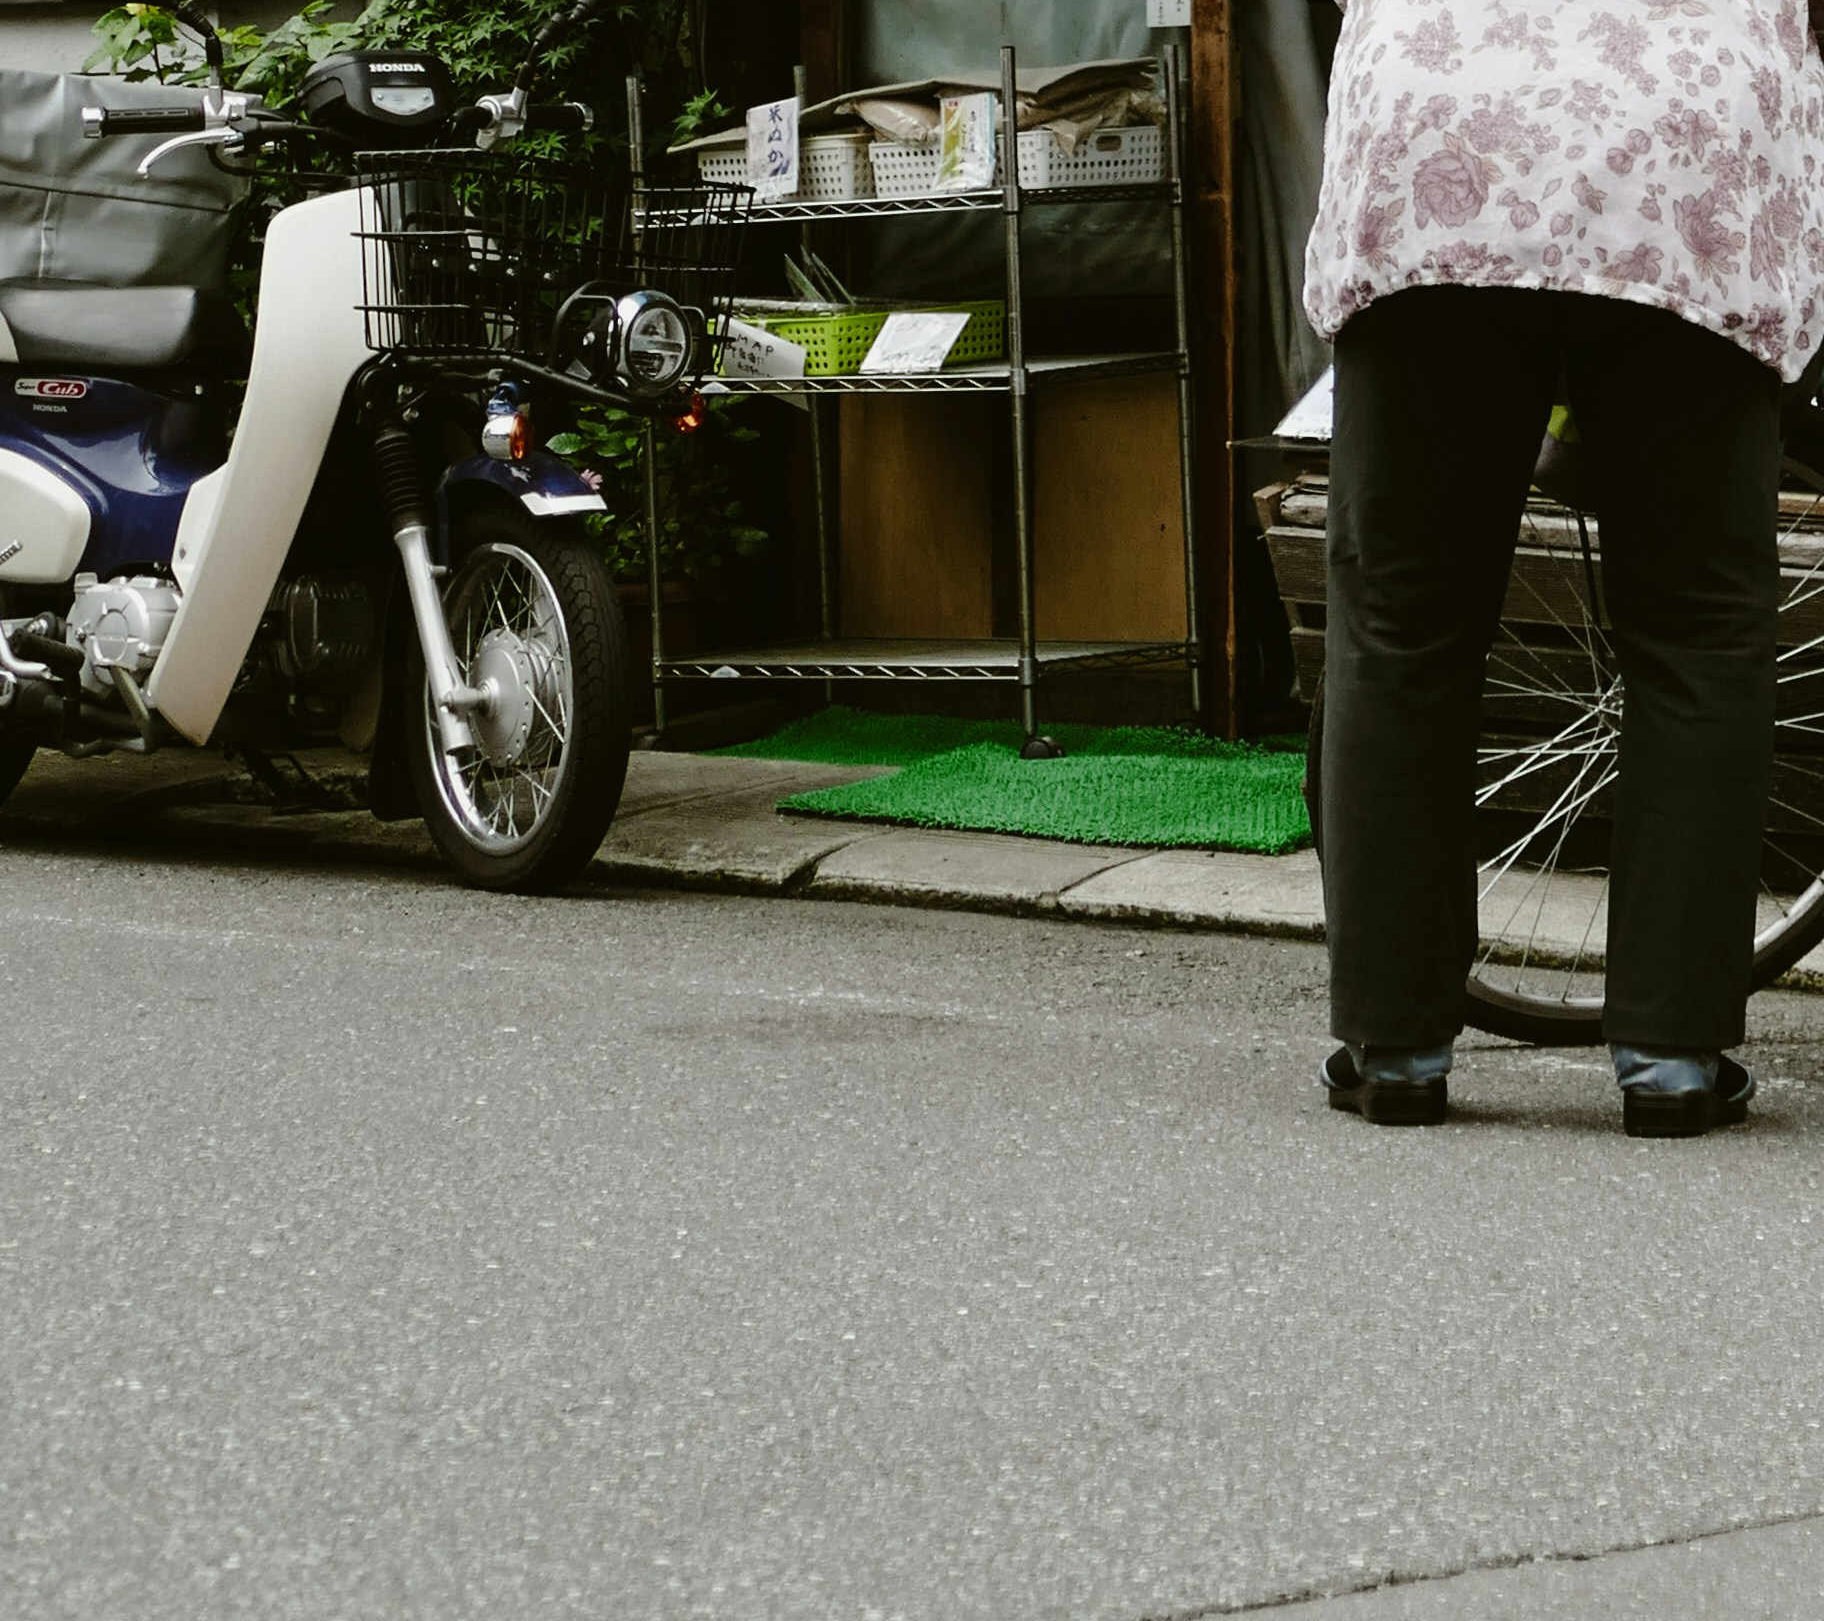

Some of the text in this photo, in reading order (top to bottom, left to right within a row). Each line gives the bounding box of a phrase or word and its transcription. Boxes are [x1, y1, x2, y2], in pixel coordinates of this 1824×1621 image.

[368, 63, 426, 73] HONDA
[42, 382, 79, 396] Cub
[32, 403, 68, 413] HONDA
